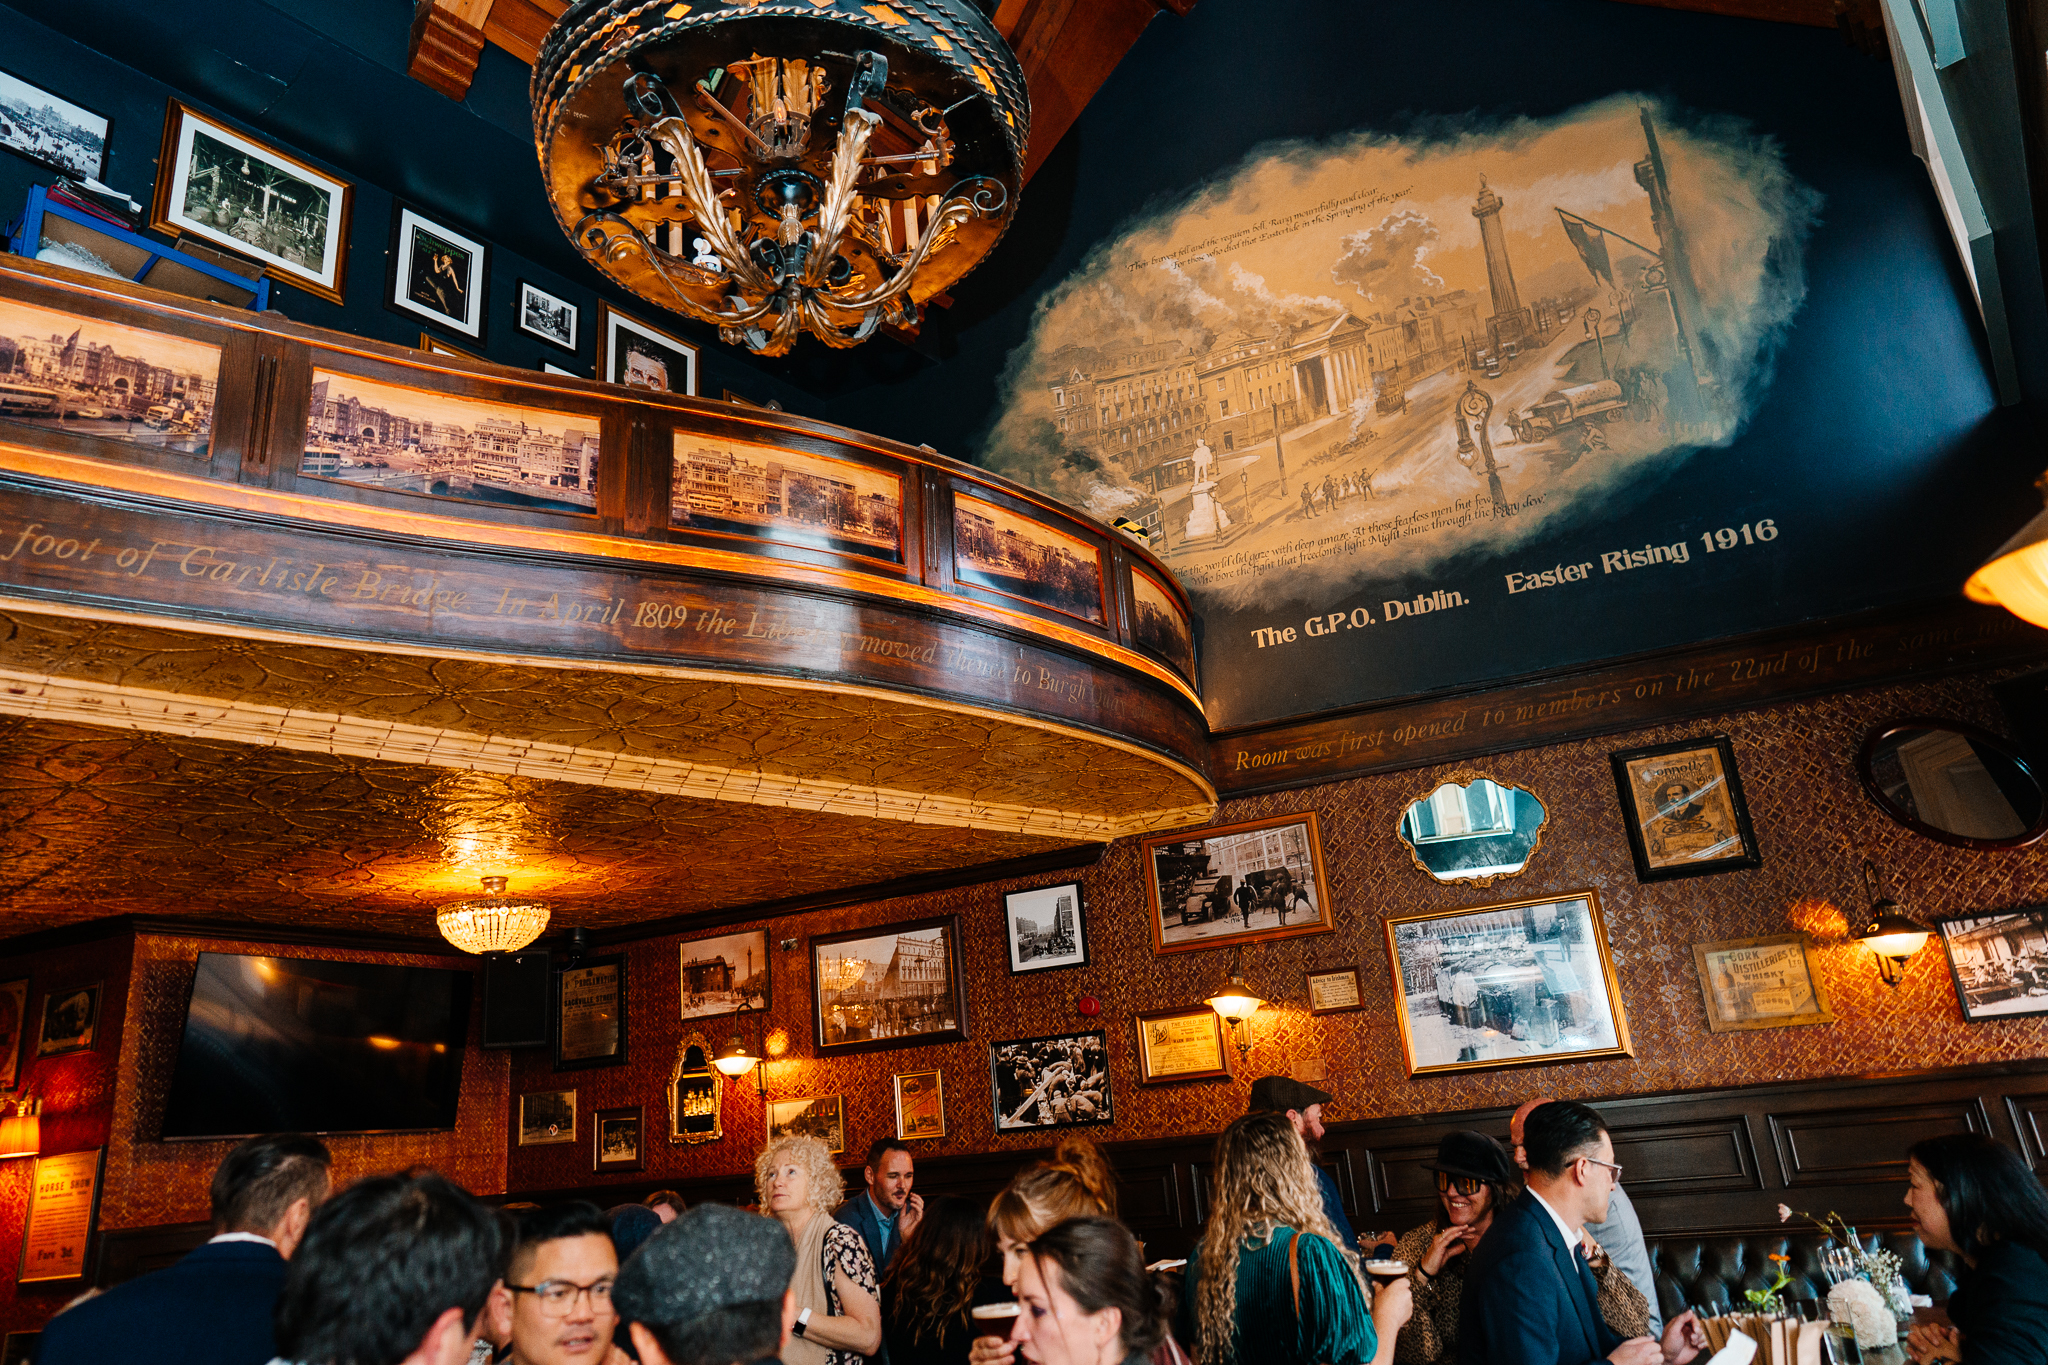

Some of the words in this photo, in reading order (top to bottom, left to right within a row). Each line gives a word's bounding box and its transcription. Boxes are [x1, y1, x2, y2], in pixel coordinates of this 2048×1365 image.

[418, 233, 465, 260] Schweppes
[1190, 241, 1206, 253] and
[1206, 236, 1219, 248] the
[1340, 190, 1357, 205] and
[1206, 246, 1223, 258] who
[1224, 239, 1240, 253] died
[1302, 220, 1310, 228] in
[1312, 214, 1325, 225] the
[1326, 203, 1366, 222] Springing
[1367, 197, 1376, 212] of
[1377, 193, 1390, 204] the
[1190, 564, 1204, 575] the
[1205, 554, 1232, 571] world
[1232, 551, 1249, 565] did
[1249, 550, 1269, 566] gaze
[1271, 541, 1293, 555] with
[1294, 539, 1315, 552] deep
[1352, 526, 1366, 538] At
[1368, 521, 1393, 534] those
[1394, 510, 1429, 530] fearless
[1431, 506, 1453, 519] men
[1455, 498, 1472, 512] but
[1192, 571, 1214, 585] Who
[1215, 569, 1234, 582] bore
[1236, 563, 1251, 576] the
[1252, 559, 1275, 577] fight
[1277, 554, 1297, 567] that
[1344, 537, 1367, 556] light
[1368, 528, 1400, 547] Might
[1403, 524, 1430, 538] shine
[1431, 509, 1471, 528] through
[1474, 507, 1490, 520] the
[1490, 502, 1520, 521] foggy
[1504, 562, 1594, 595] Easter
[1600, 541, 1691, 575] Rising
[1700, 518, 1779, 553] 1916
[0, 523, 102, 561] foot
[116, 541, 167, 578] of
[180, 545, 339, 595] Carlisle
[493, 587, 529, 616] In
[538, 592, 626, 627] April
[631, 600, 689, 631] 1809
[695, 608, 737, 635] the
[858, 634, 938, 665] moved
[1013, 664, 1031, 685] to
[1037, 666, 1086, 705] Burgh
[1251, 626, 1298, 649] The
[1304, 607, 1376, 637] G.P.O.
[1383, 589, 1470, 622] Dublin.
[1235, 750, 1288, 772] Room
[1294, 741, 1332, 761] was
[1336, 730, 1385, 759] first
[1392, 709, 1467, 745] opened
[1481, 709, 1506, 728] to
[1515, 687, 1623, 720] members
[1634, 681, 1664, 700] on
[1675, 667, 1715, 693] the
[1730, 652, 1789, 683] 22nd
[1797, 644, 1824, 674] of
[1835, 637, 1875, 664] the
[1729, 950, 1760, 963] CORK
[1732, 949, 1789, 974] DISTILLERIES
[1742, 970, 1784, 981] WHISKY
[564, 996, 594, 1008] SACKVILLE
[596, 993, 617, 1004] STREET
[39, 1181, 65, 1194] HORSE
[70, 1178, 92, 1190] SHOW
